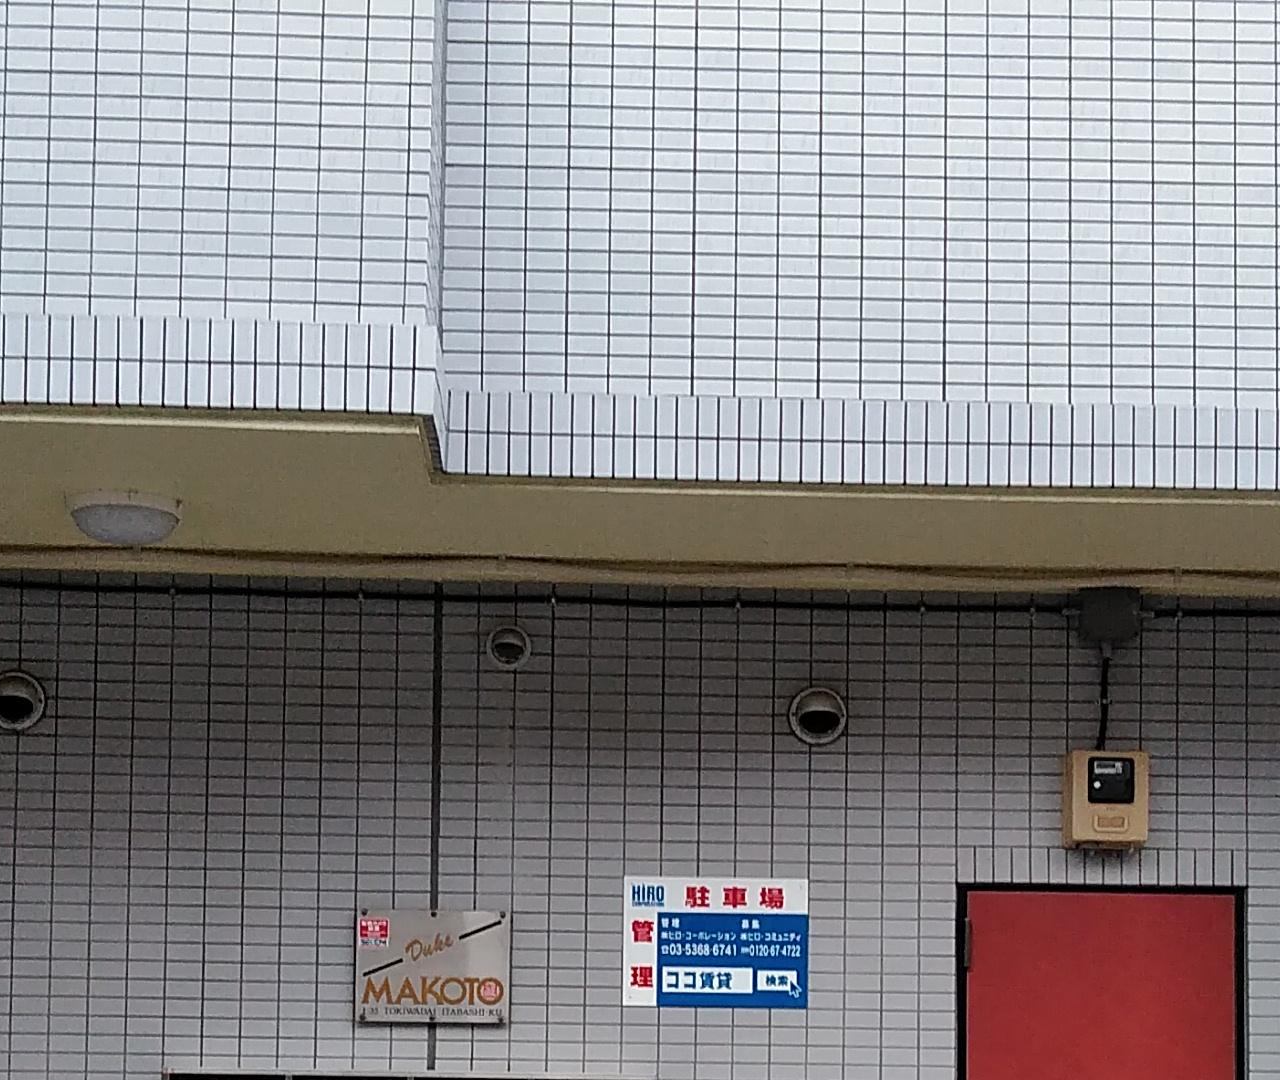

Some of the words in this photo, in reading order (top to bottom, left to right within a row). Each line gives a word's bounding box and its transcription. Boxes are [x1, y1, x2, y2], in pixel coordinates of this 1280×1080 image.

[684, 886, 785, 909] 駐車場
[405, 933, 454, 962] Duke
[361, 976, 505, 1005] MAKOTO
[666, 971, 732, 990] ココ賃貸
[765, 974, 789, 987] 検索
